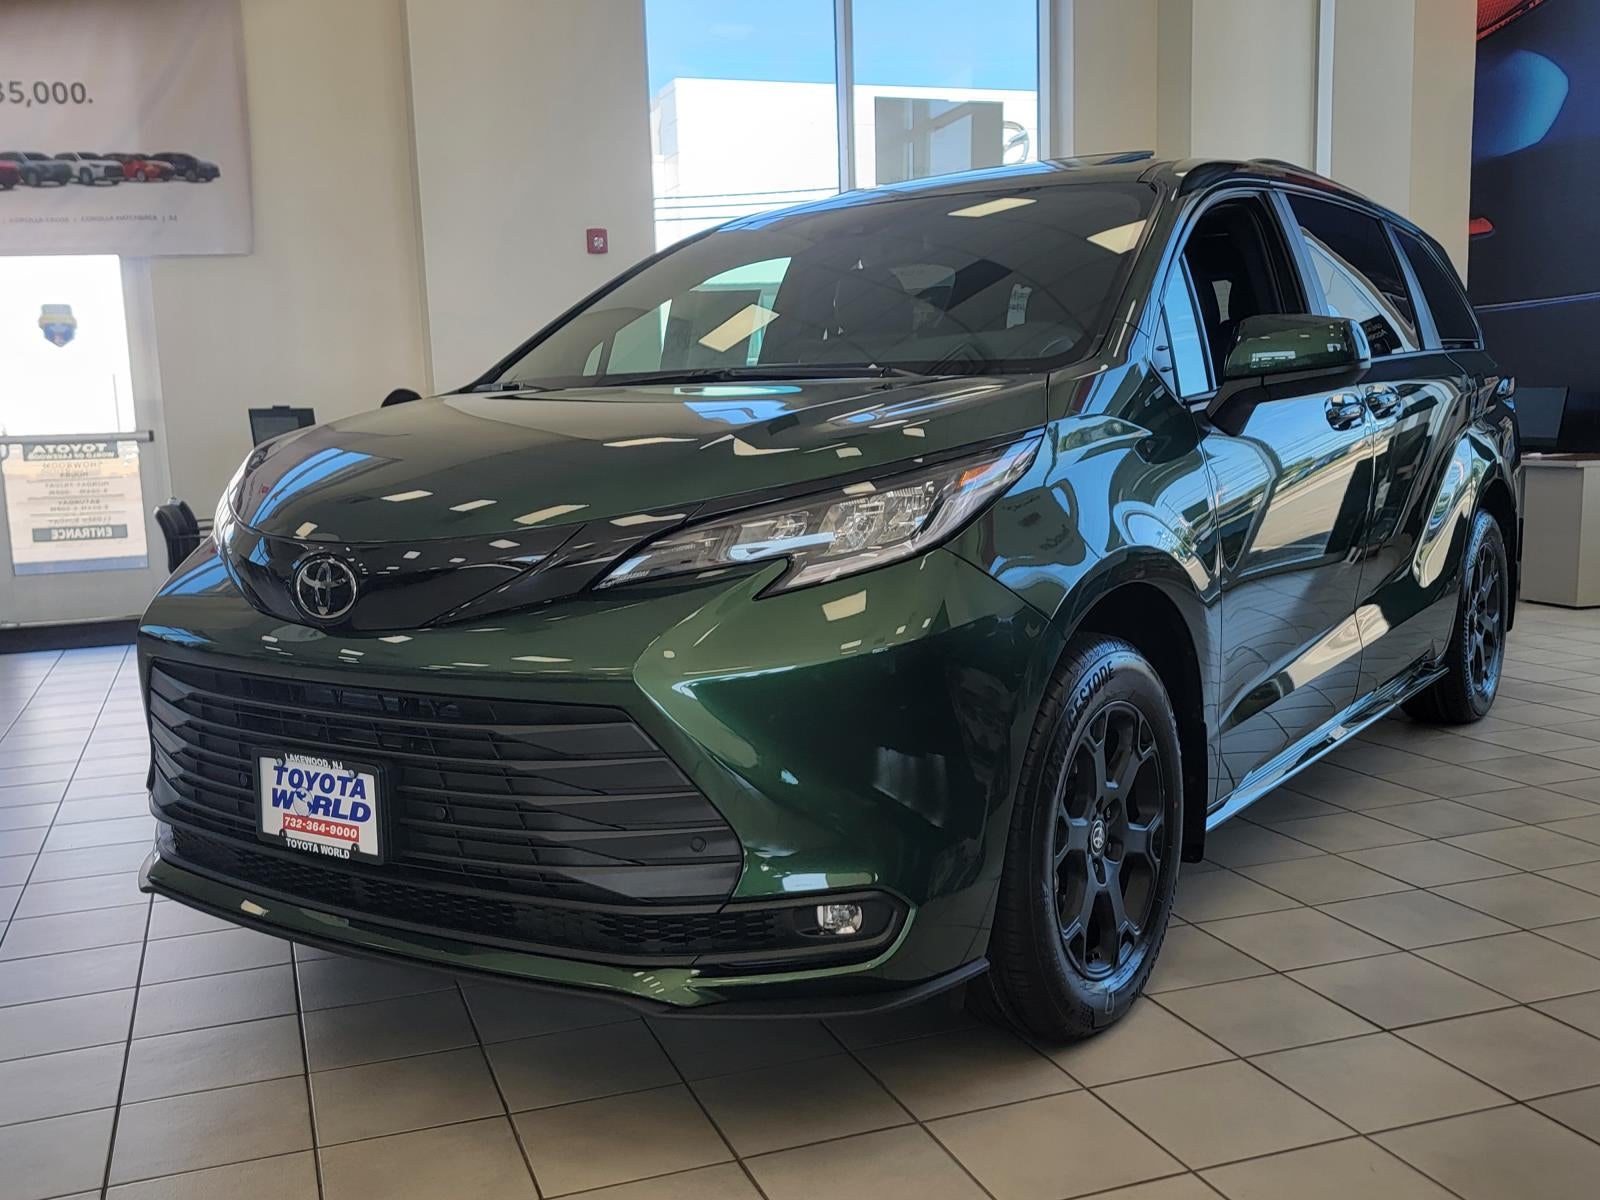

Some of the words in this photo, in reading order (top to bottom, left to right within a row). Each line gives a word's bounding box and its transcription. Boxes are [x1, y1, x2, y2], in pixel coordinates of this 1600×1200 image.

[332, 761, 344, 770] NJ
[273, 764, 367, 800] TOYOTA
[271, 787, 372, 823] WORLD
[284, 816, 358, 839] 732-364-9000
[286, 837, 319, 853] TOYOTA
[320, 844, 350, 860] WORLD
